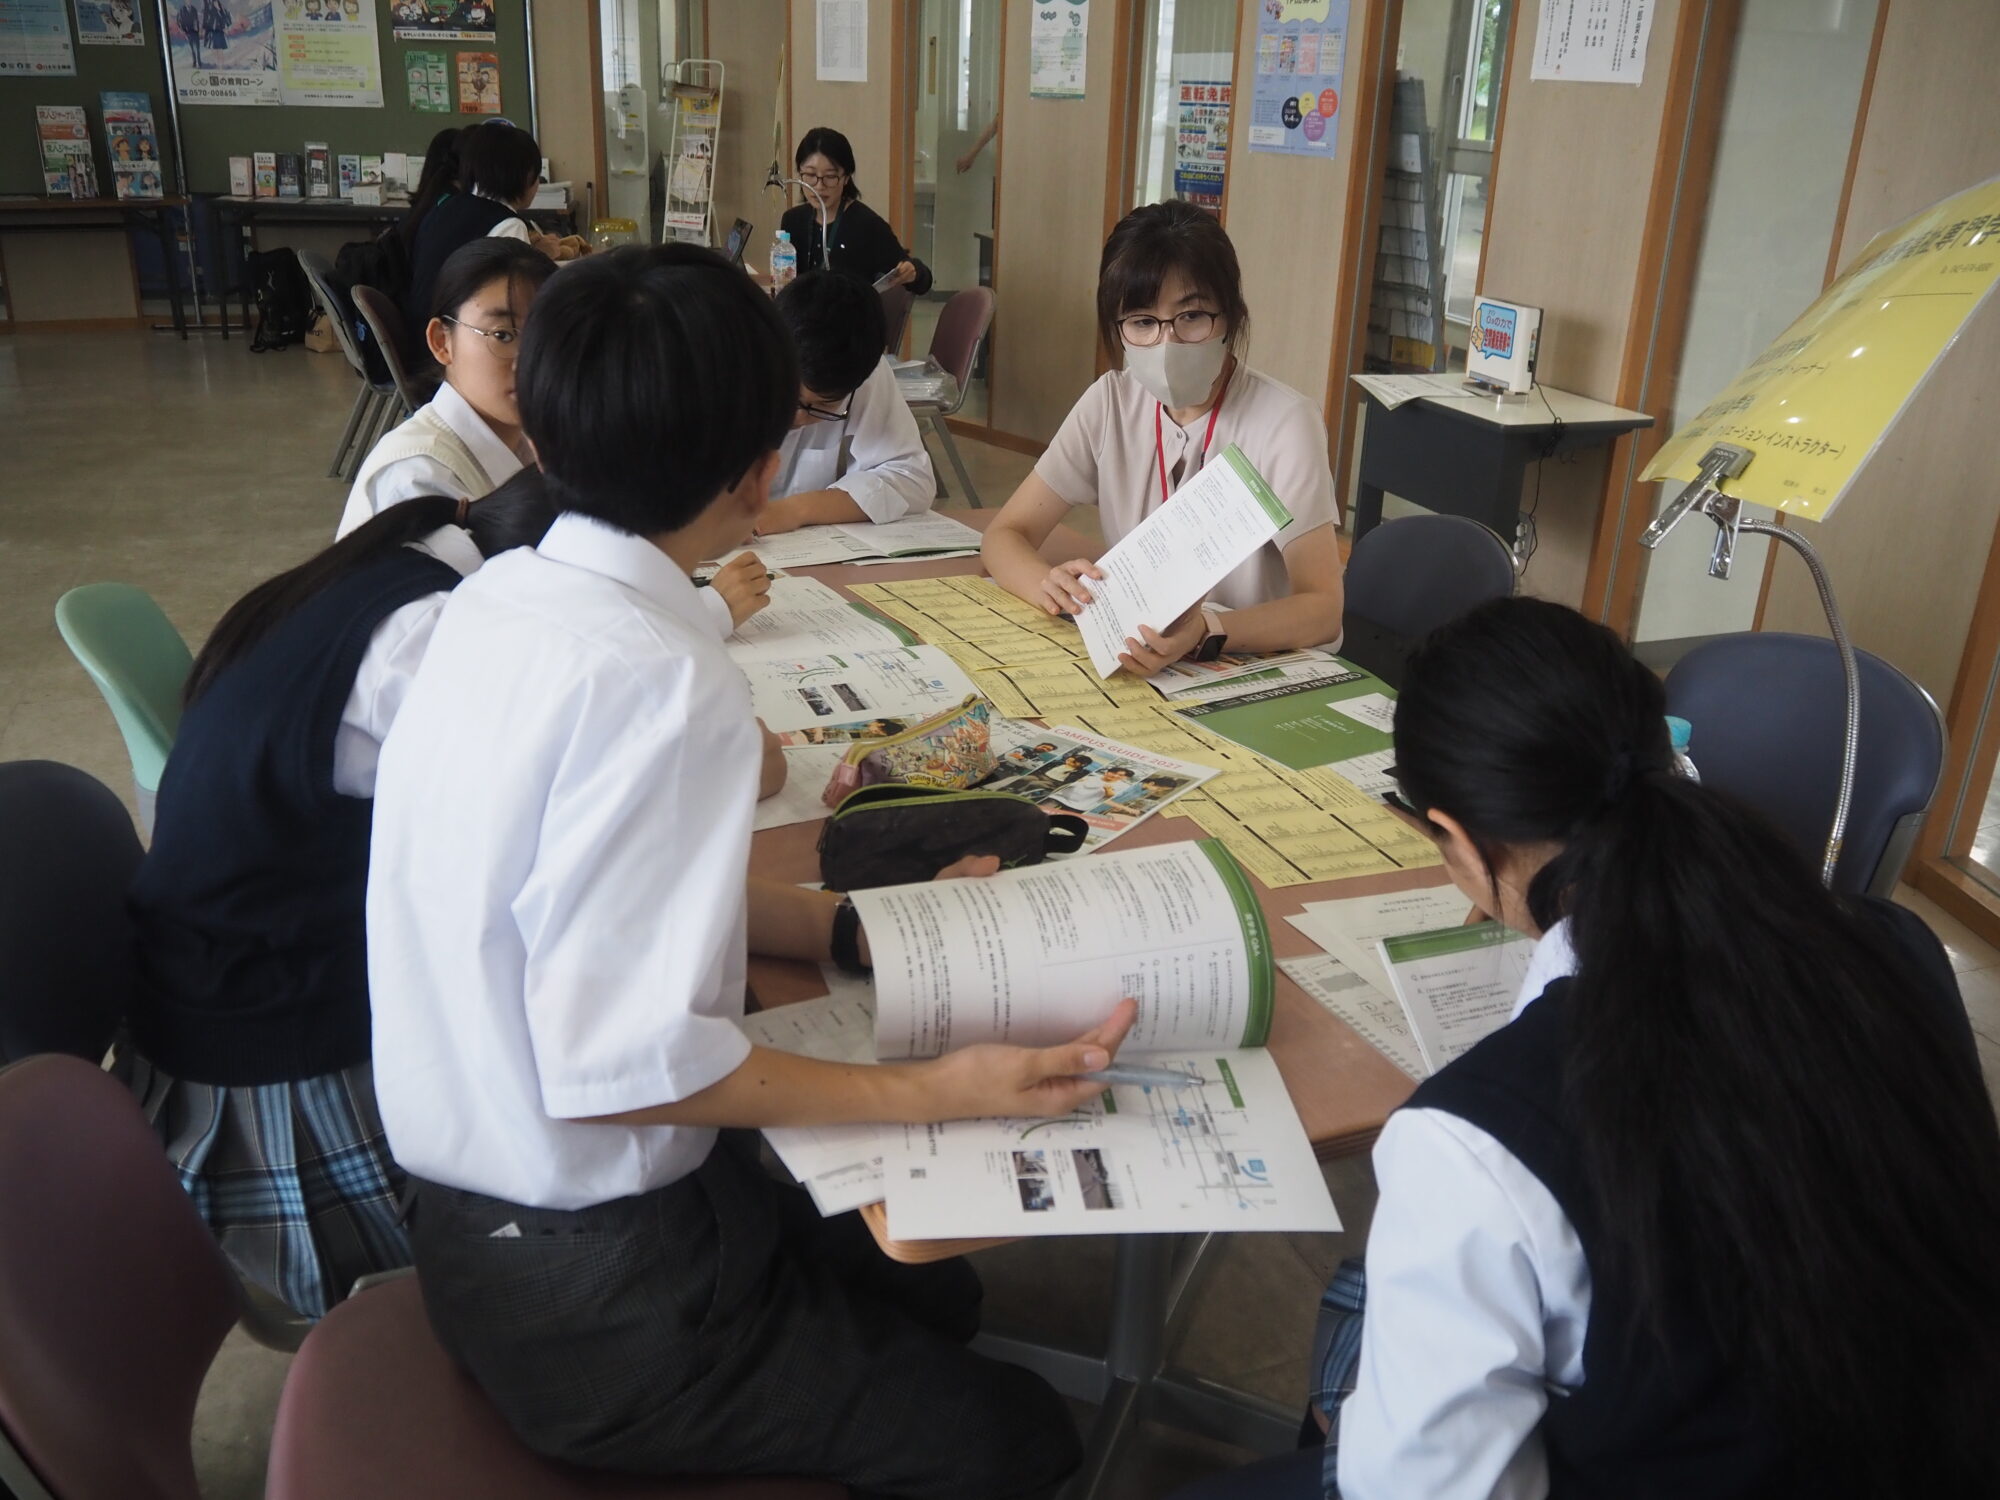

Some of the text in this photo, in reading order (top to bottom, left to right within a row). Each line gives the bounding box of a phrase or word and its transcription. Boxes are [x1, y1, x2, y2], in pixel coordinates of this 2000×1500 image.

[209, 75, 264, 86] 国の教育ローン
[1181, 86, 1231, 102] 運転免許
[1053, 727, 1184, 770] CAMPUS GUIDE 2027
